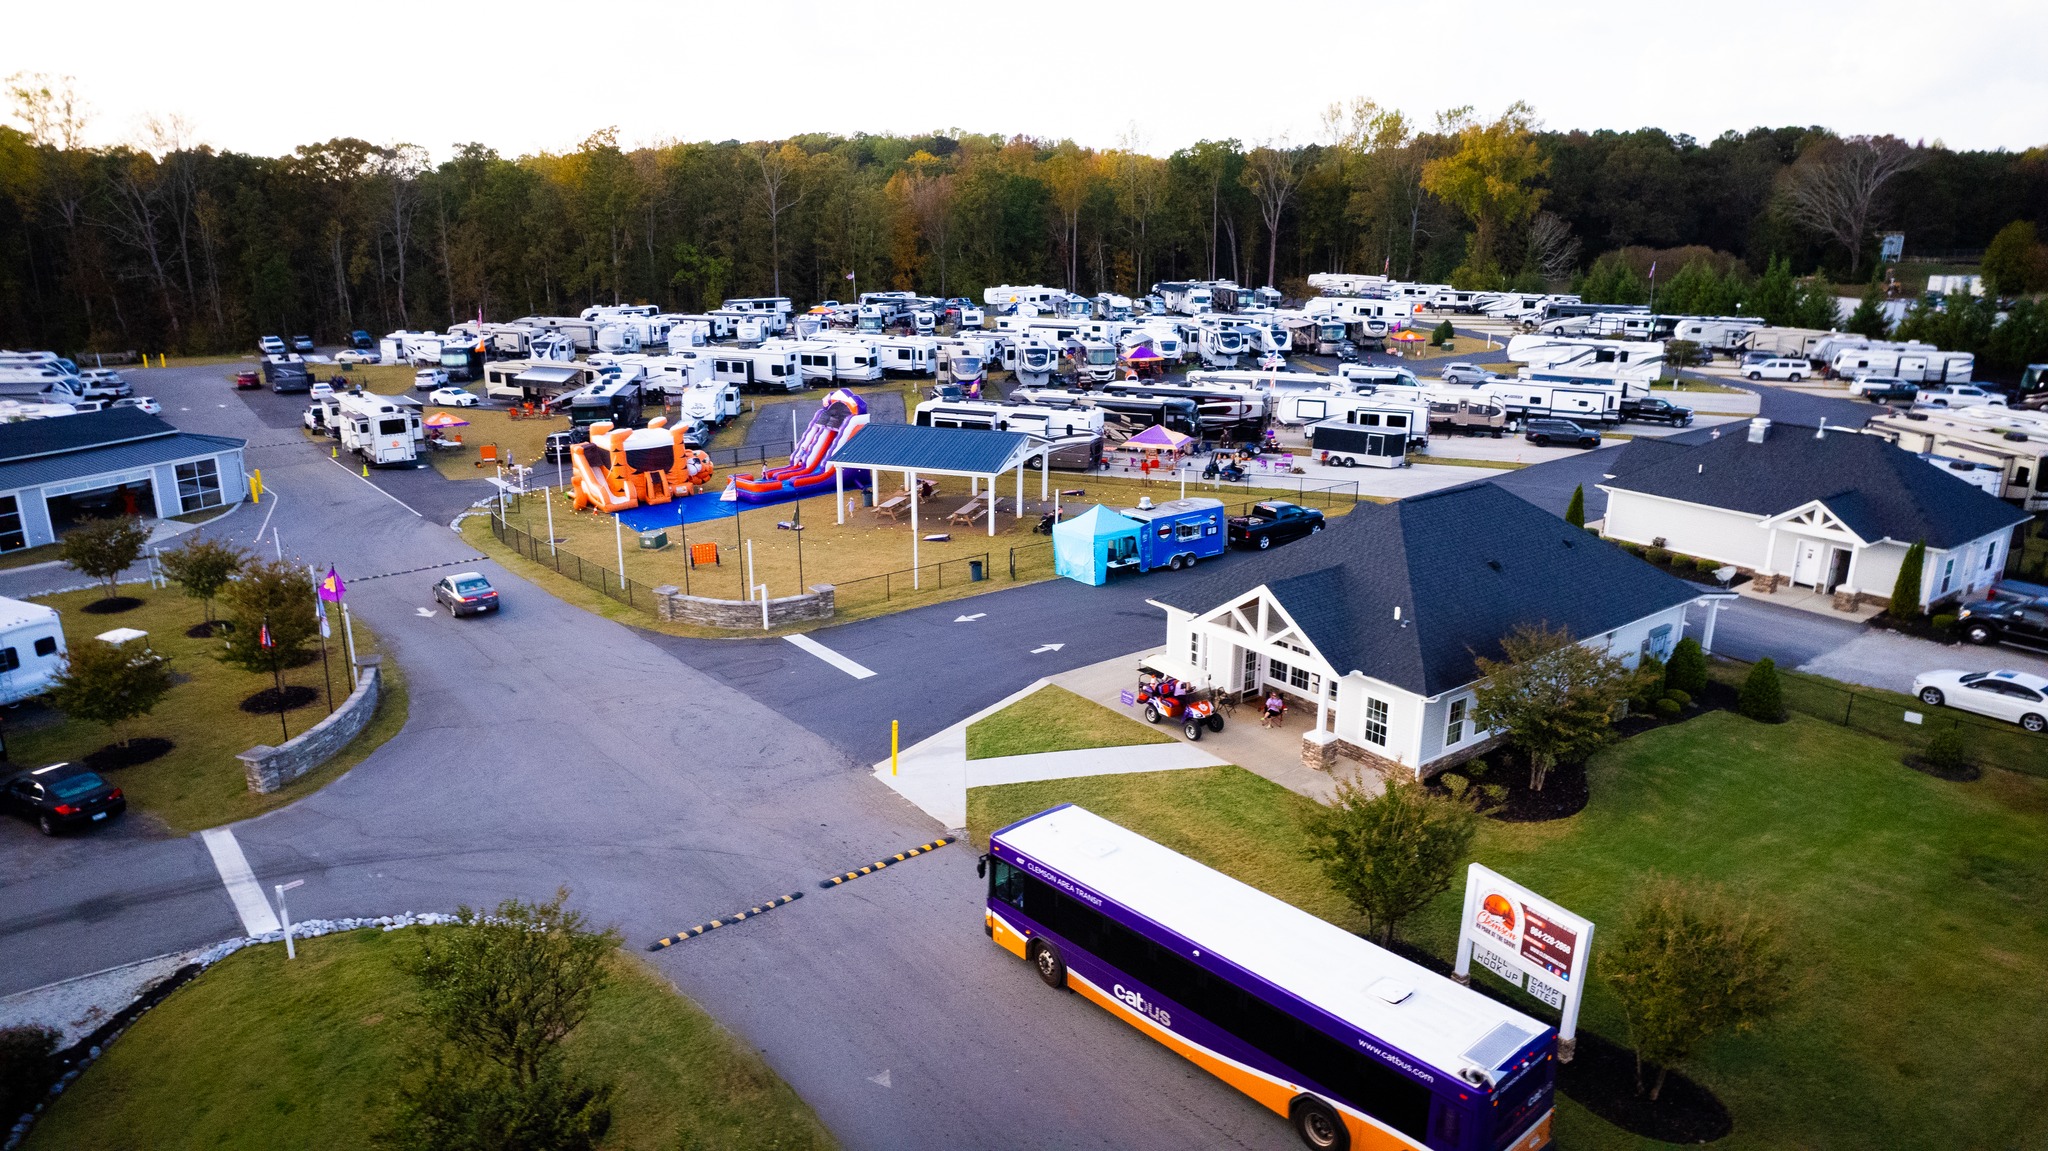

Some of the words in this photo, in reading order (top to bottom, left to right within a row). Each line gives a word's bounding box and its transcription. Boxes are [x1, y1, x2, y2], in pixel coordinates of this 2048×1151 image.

[1027, 862, 1057, 883] CLEMSON
[1057, 878, 1075, 893] AREA
[1075, 887, 1103, 907] TRANSIT
[1476, 910, 1517, 941] Clemson
[1477, 953, 1502, 974] HOOK
[1505, 970, 1518, 981] UP
[1486, 950, 1508, 968] FULL
[1529, 985, 1558, 1006] SITES
[1531, 977, 1560, 996] CAMP
[1113, 983, 1171, 1027] catbus
[1358, 1038, 1434, 1084] www.catbus.com
